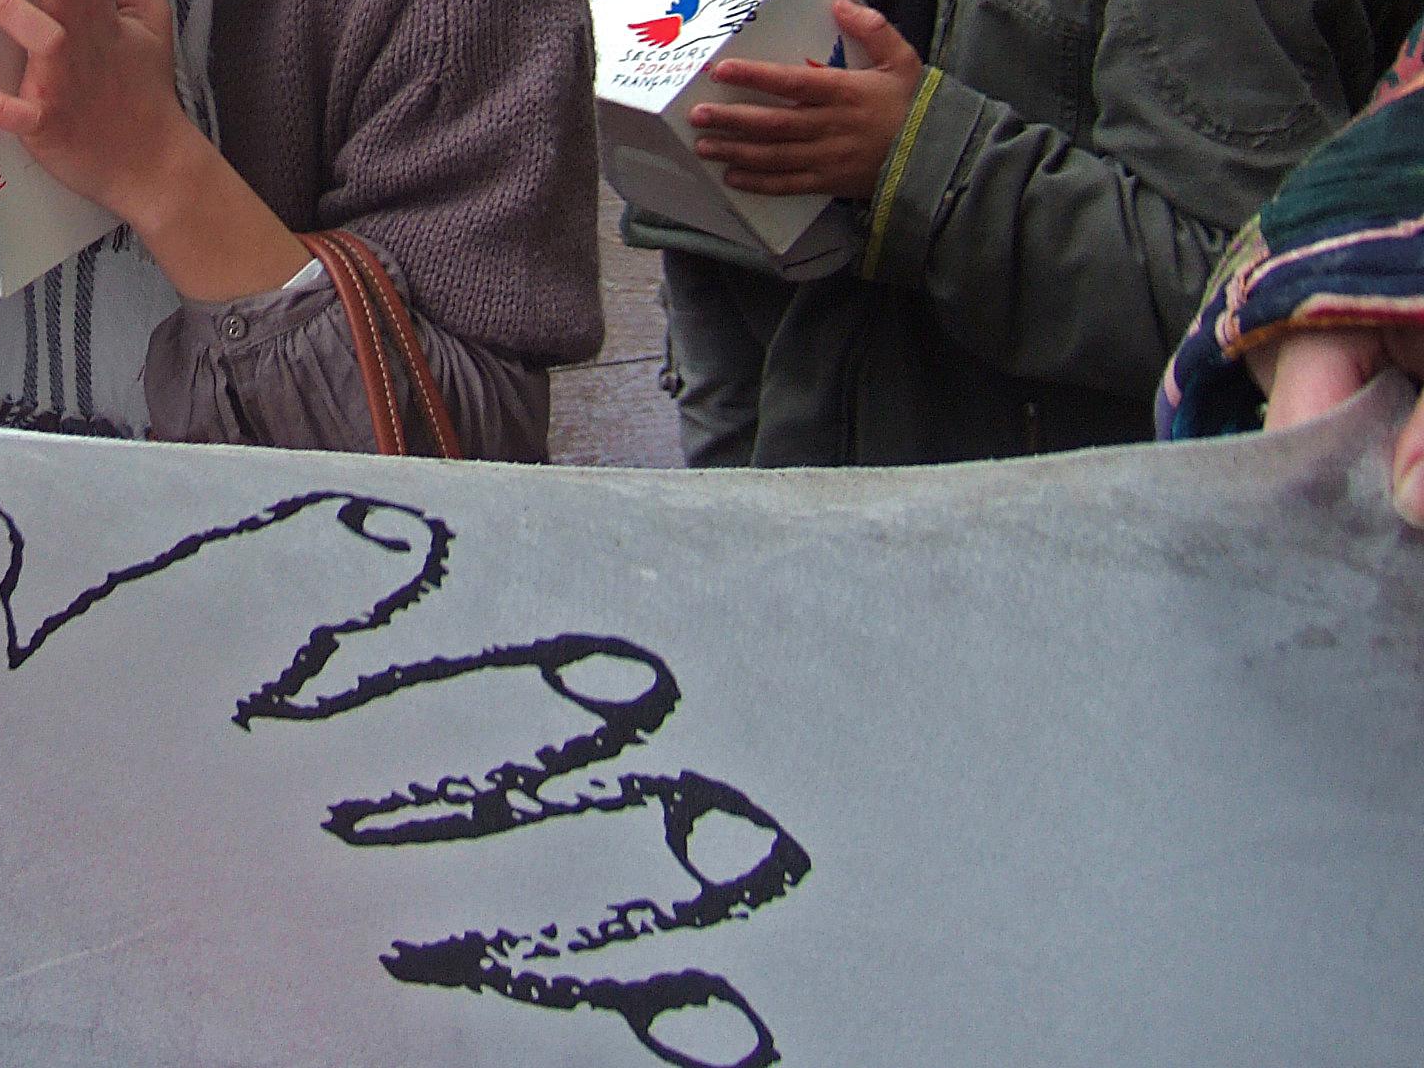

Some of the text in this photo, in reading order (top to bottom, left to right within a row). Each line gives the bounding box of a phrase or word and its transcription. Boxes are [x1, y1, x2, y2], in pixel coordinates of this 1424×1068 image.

[618, 46, 711, 63] SECOURS
[634, 61, 713, 76] POPULAIR
[611, 73, 688, 92] FRANÇAIS
